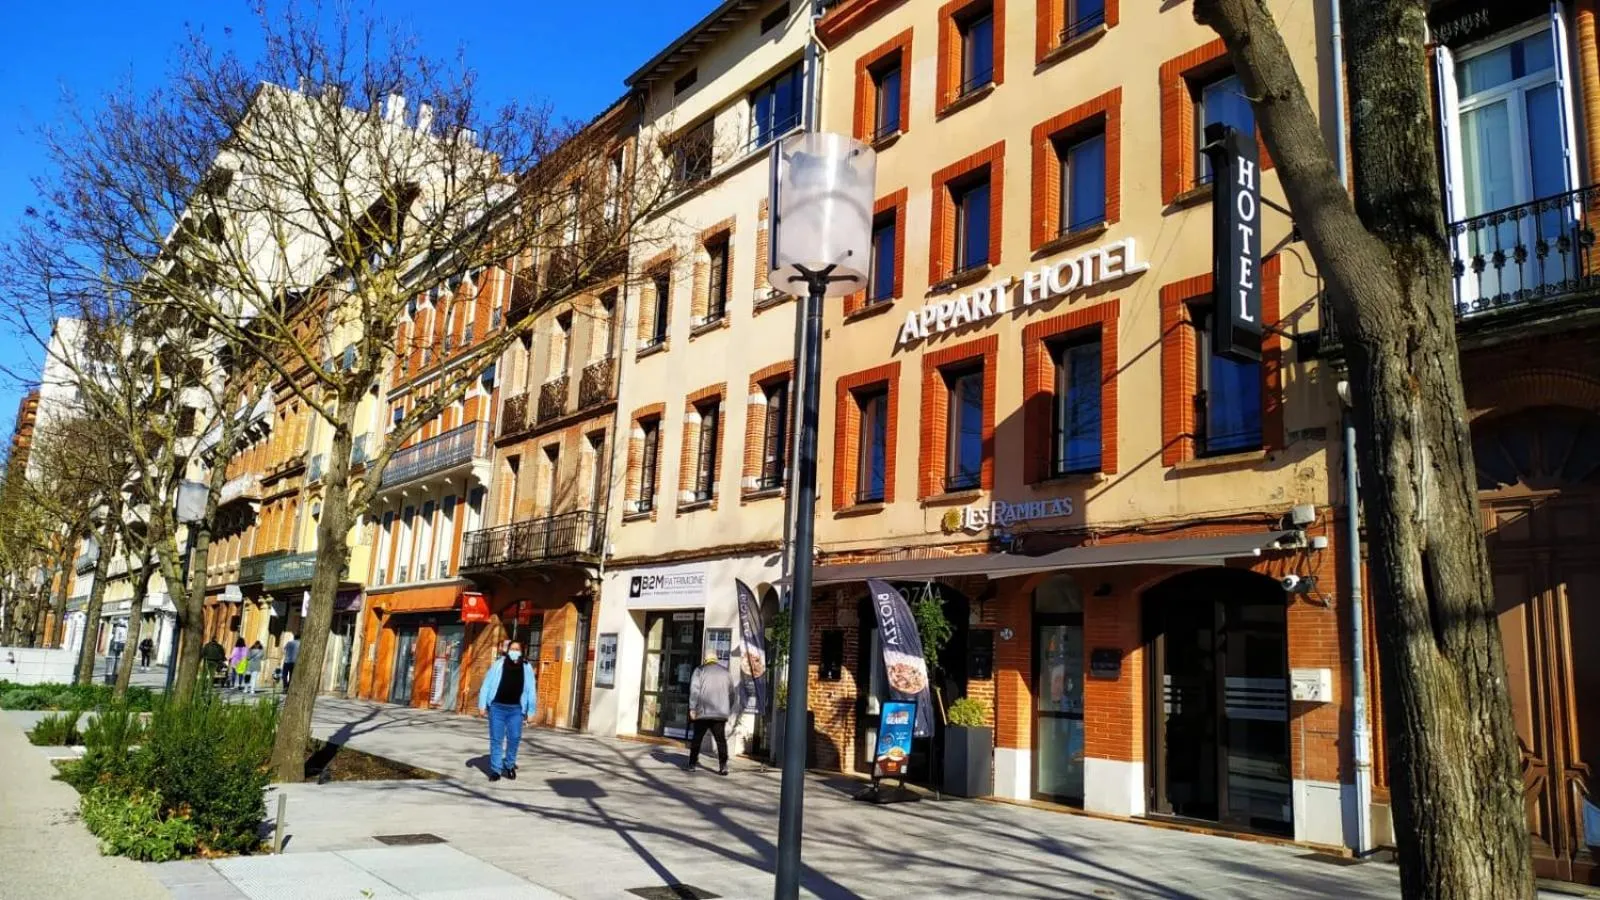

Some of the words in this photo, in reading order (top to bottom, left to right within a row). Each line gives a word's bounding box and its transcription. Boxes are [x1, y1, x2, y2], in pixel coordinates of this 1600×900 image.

[1237, 156, 1255, 322] HOTEL
[899, 279, 1011, 343] APPART
[1023, 237, 1151, 305] HOTEL
[963, 505, 990, 531] LES
[991, 497, 1073, 526] RAMBLAS
[641, 575, 664, 590] B2M
[664, 575, 705, 586] PATRIMOINE
